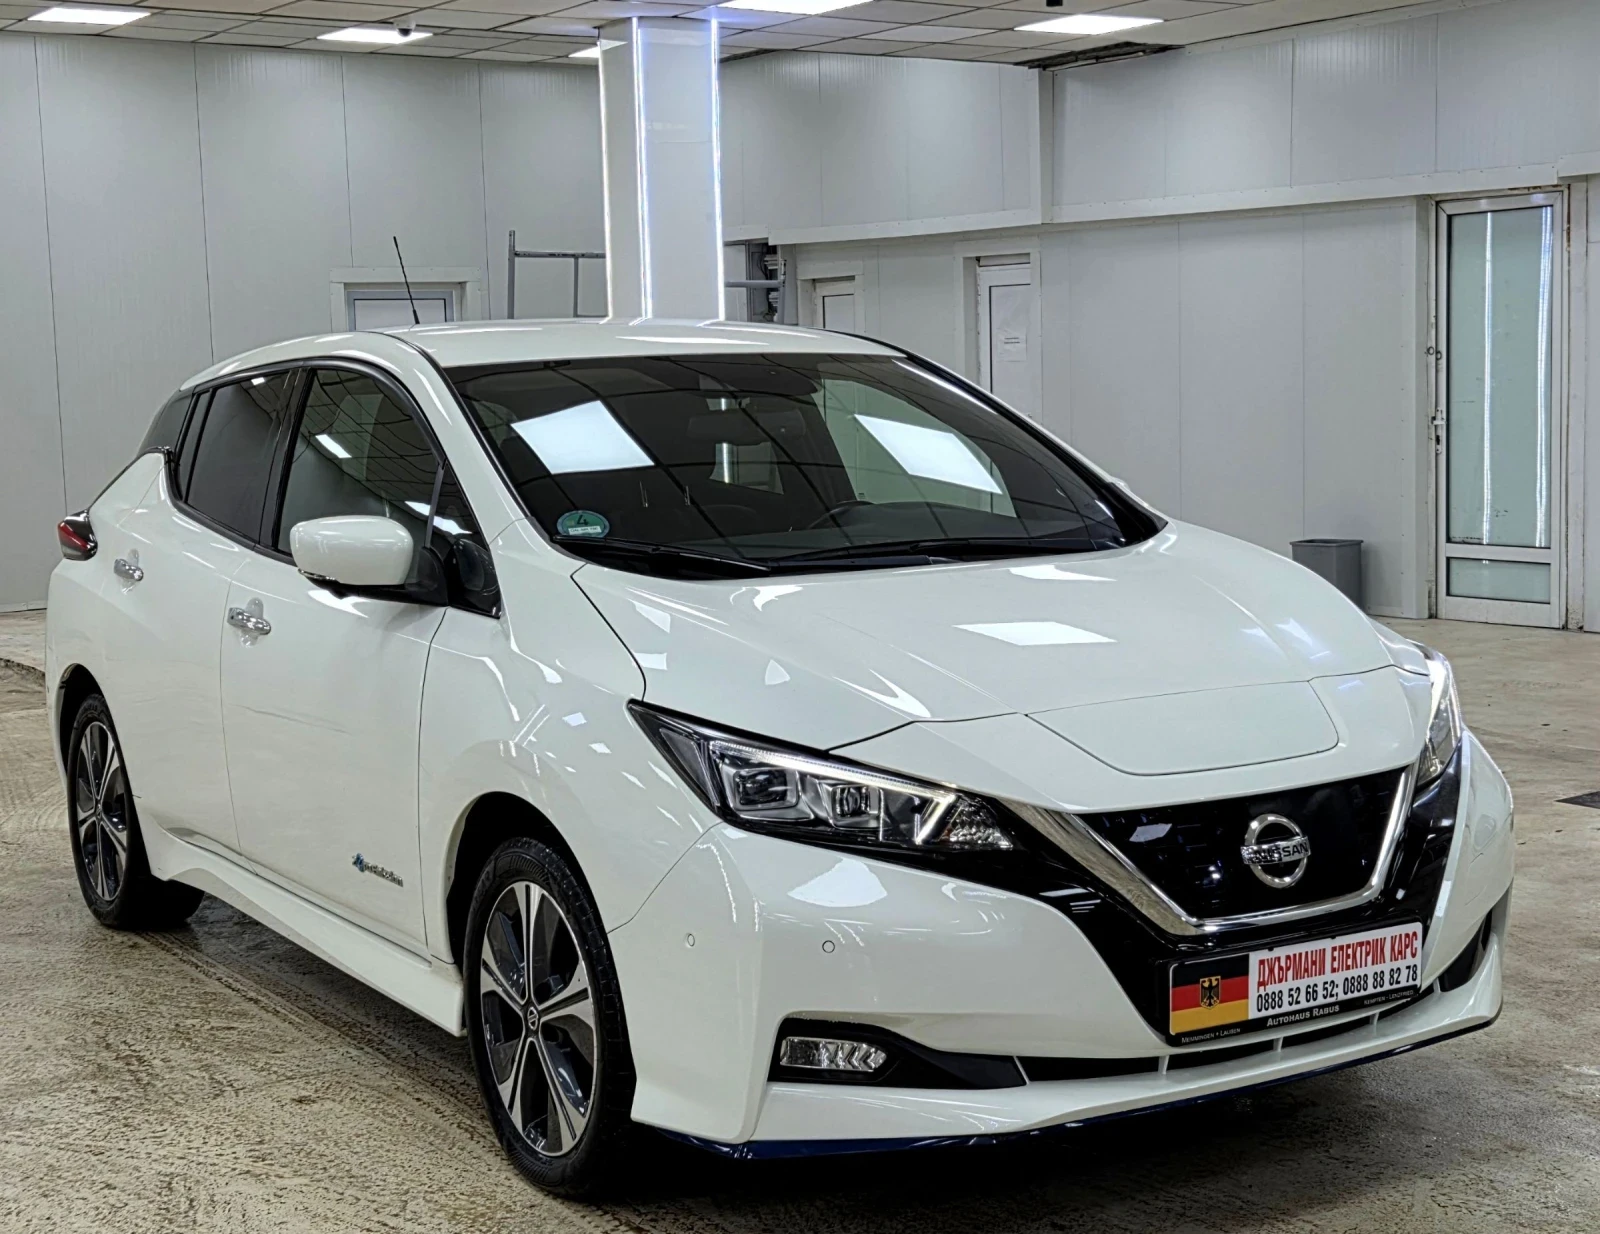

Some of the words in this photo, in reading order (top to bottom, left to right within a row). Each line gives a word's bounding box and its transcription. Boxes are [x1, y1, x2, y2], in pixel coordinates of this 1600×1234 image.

[576, 514, 589, 526] 4
[1252, 842, 1308, 861] NISSAN
[1257, 948, 1326, 993] ДЖЪРМАНИ
[1331, 937, 1386, 974] ЕЛЕКТРИК
[1390, 931, 1418, 962] КАРС
[1257, 990, 1283, 1012] 0888
[1288, 986, 1301, 1006] 52
[1305, 983, 1318, 1003] 66
[1322, 980, 1339, 1001] 52;
[1343, 973, 1369, 995] 0888
[1372, 970, 1385, 990] 88
[1389, 967, 1401, 986] 82
[1405, 964, 1418, 983] 78
